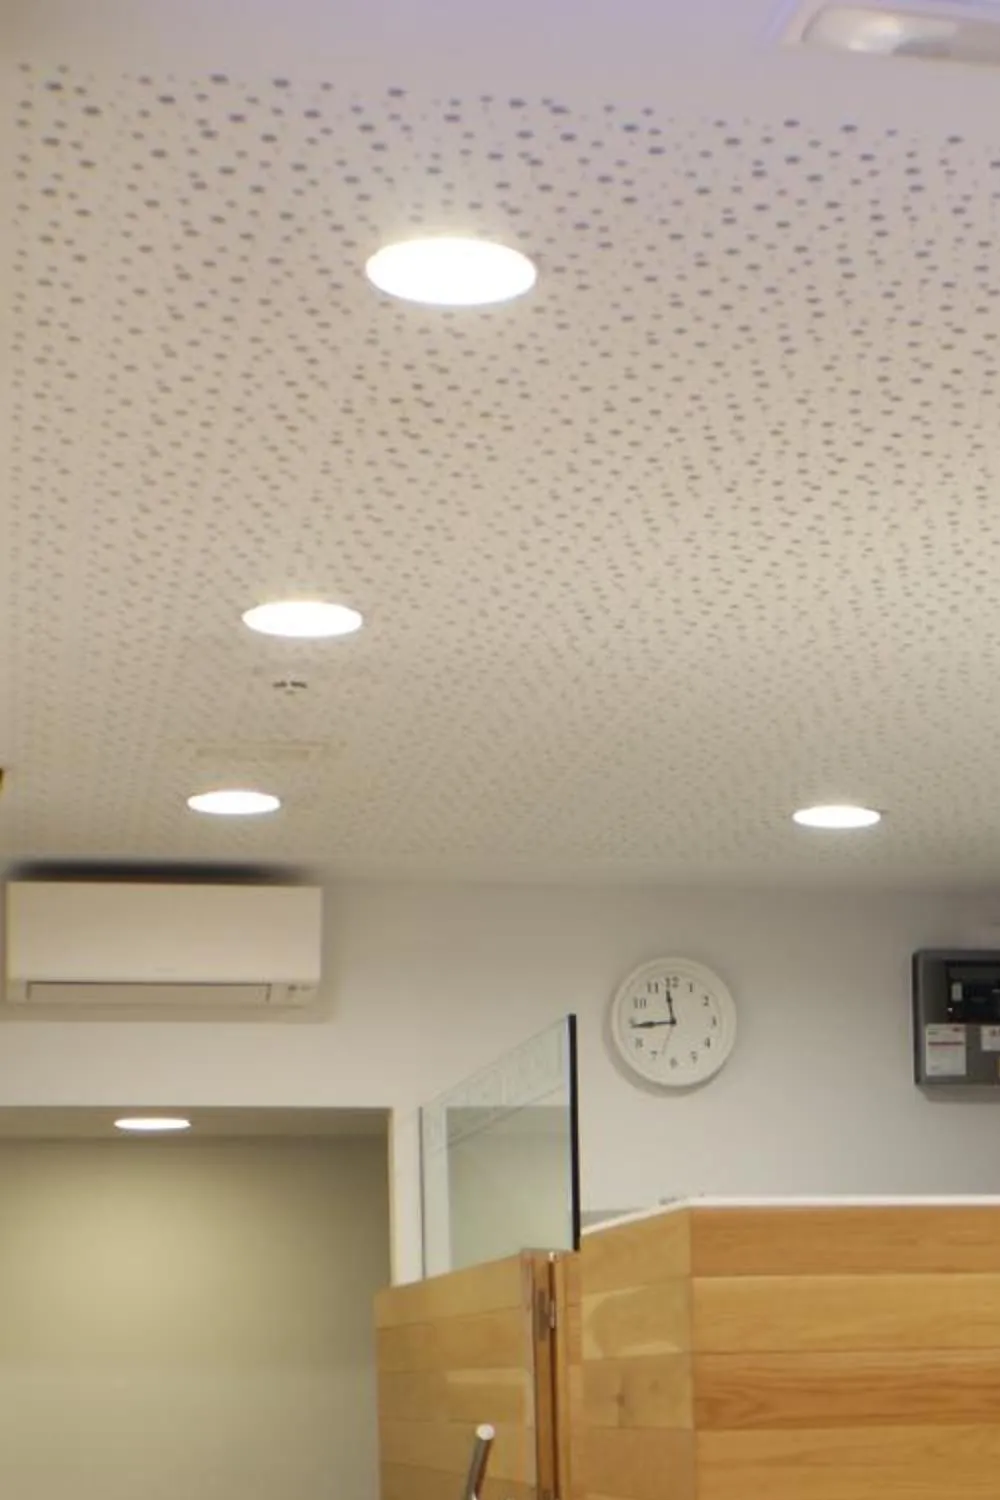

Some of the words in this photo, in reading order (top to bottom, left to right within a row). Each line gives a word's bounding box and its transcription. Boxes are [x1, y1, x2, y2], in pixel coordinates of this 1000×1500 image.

[647, 982, 659, 994] 11
[633, 997, 647, 1009] 10
[703, 995, 710, 1007] 2
